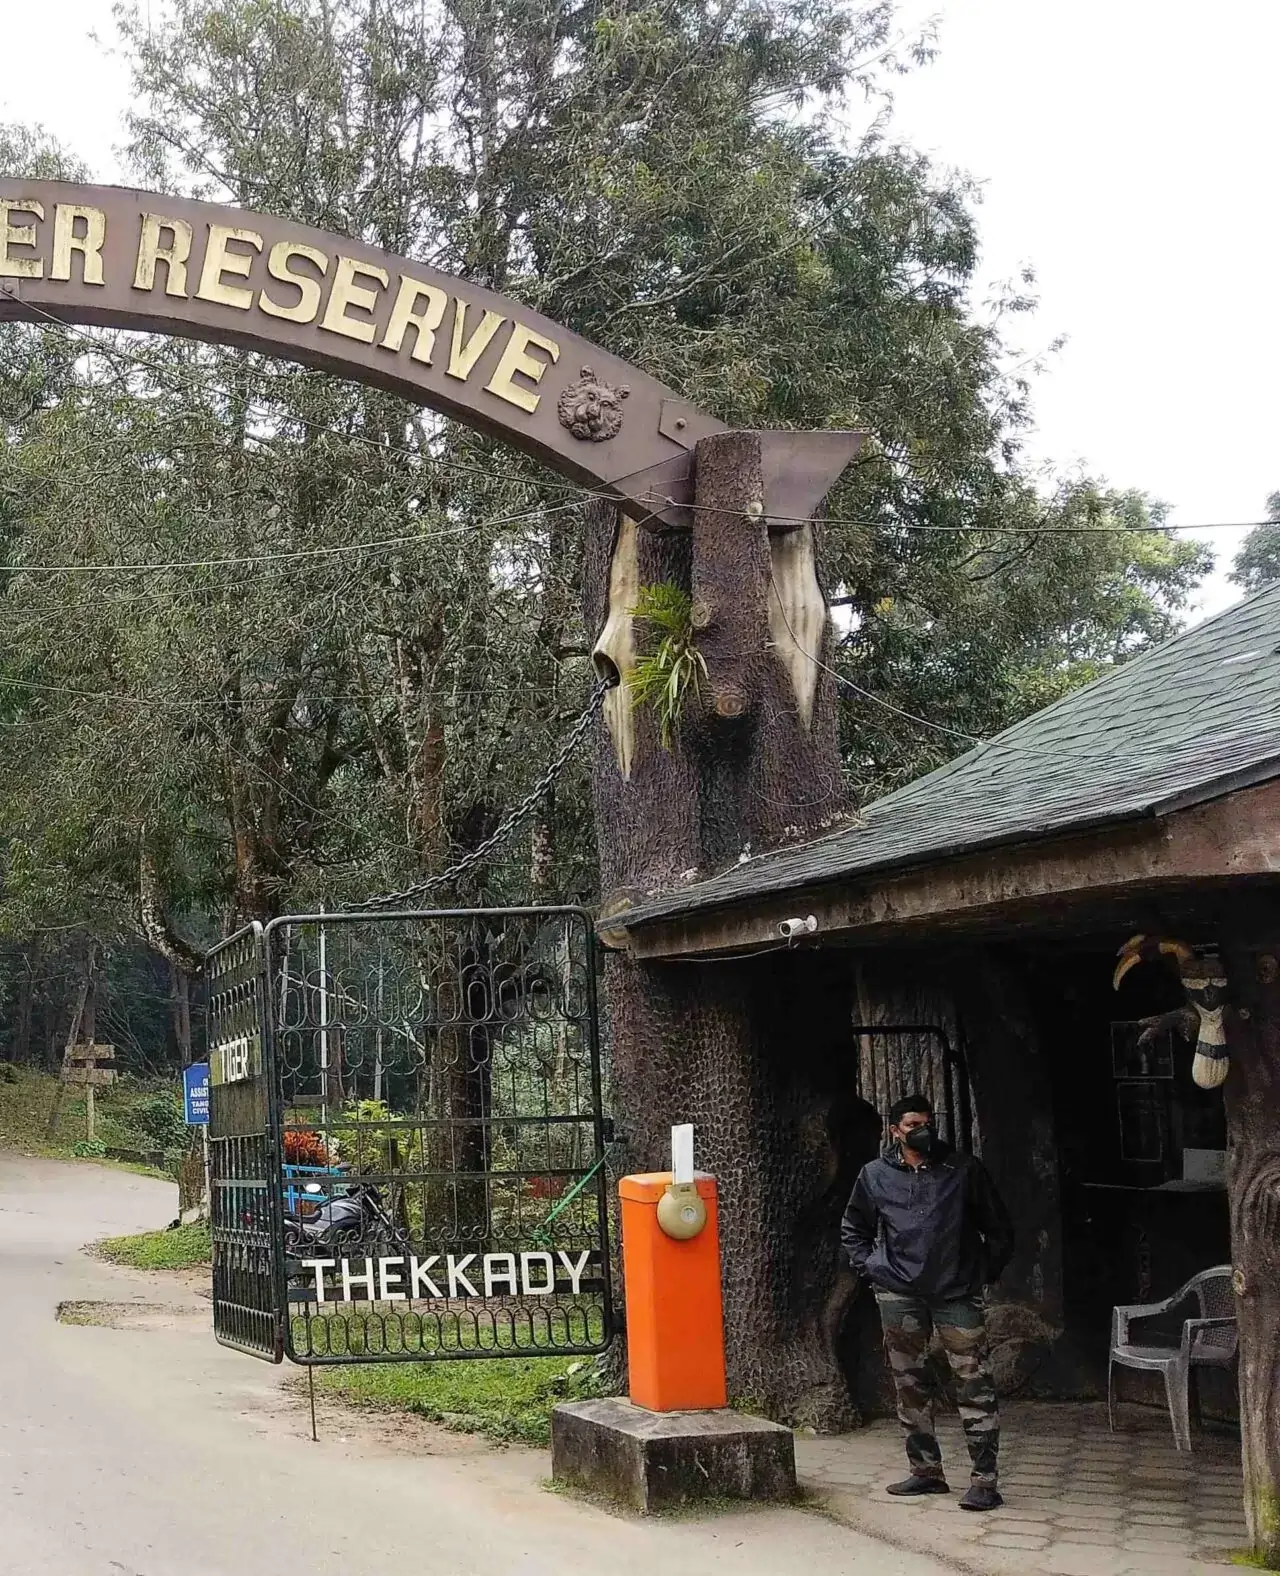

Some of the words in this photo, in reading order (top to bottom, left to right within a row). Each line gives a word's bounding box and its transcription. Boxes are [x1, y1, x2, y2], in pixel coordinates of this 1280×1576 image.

[131, 210, 560, 415] RESERVE
[218, 1037, 249, 1086] TIGER
[302, 1250, 590, 1302] THEKKADY
